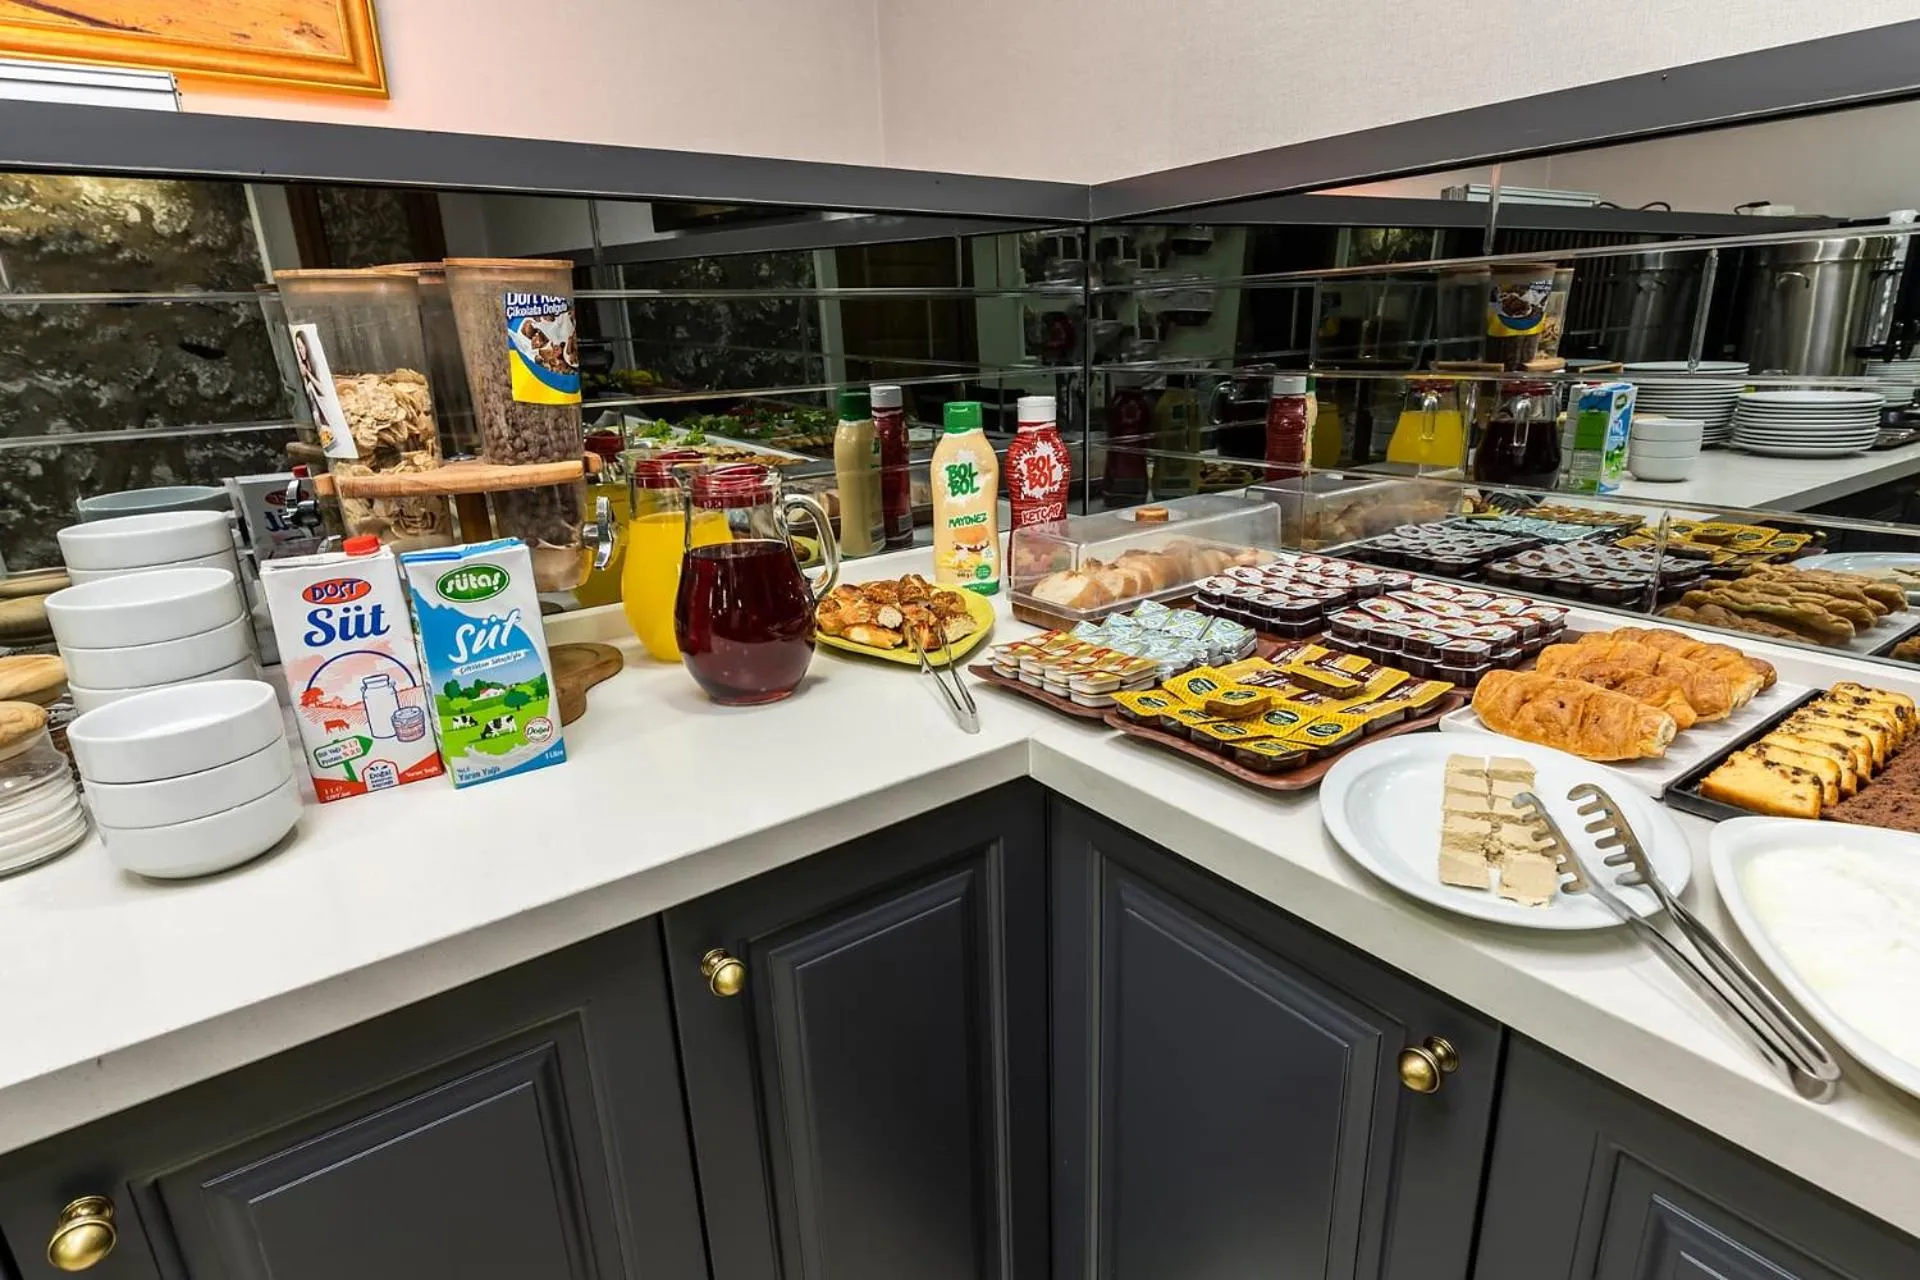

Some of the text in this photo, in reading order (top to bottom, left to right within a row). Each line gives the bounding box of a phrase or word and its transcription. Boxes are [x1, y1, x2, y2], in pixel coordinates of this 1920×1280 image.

[507, 305, 542, 320] Çikolata
[946, 462, 979, 479] BOL
[1024, 455, 1056, 472] BOL
[948, 477, 980, 497] BOL
[1027, 471, 1057, 490] BOL
[948, 512, 988, 528] MAYONEZ
[311, 579, 364, 601] DOST
[304, 604, 390, 647] Süt
[448, 608, 522, 664] Süt
